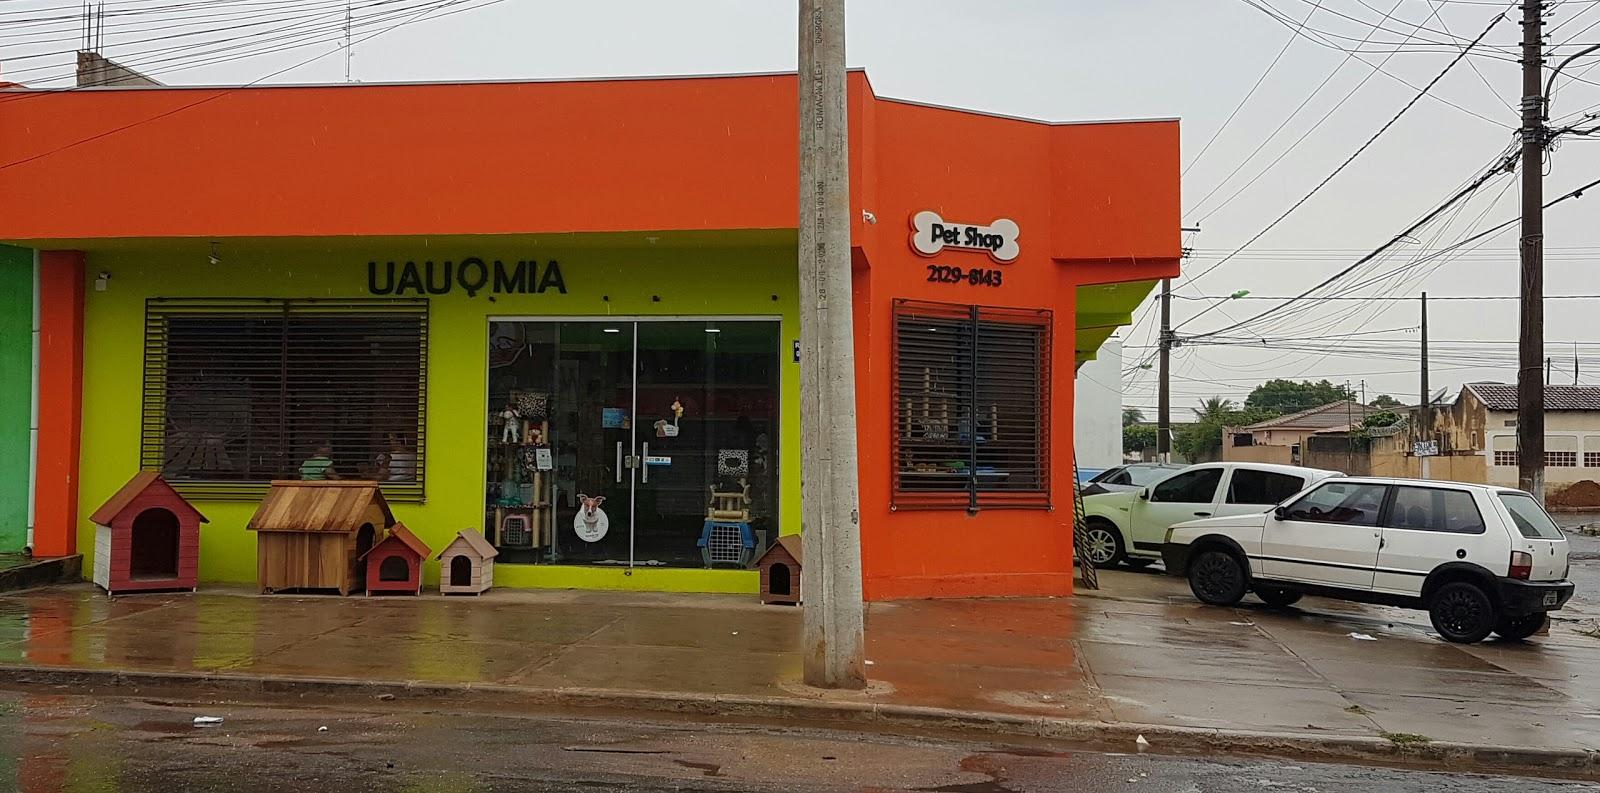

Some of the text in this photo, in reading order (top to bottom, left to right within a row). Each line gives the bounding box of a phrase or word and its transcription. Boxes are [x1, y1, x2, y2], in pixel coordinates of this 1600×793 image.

[931, 223, 1004, 251] Pet Shop
[927, 265, 1002, 287] 2129-8143
